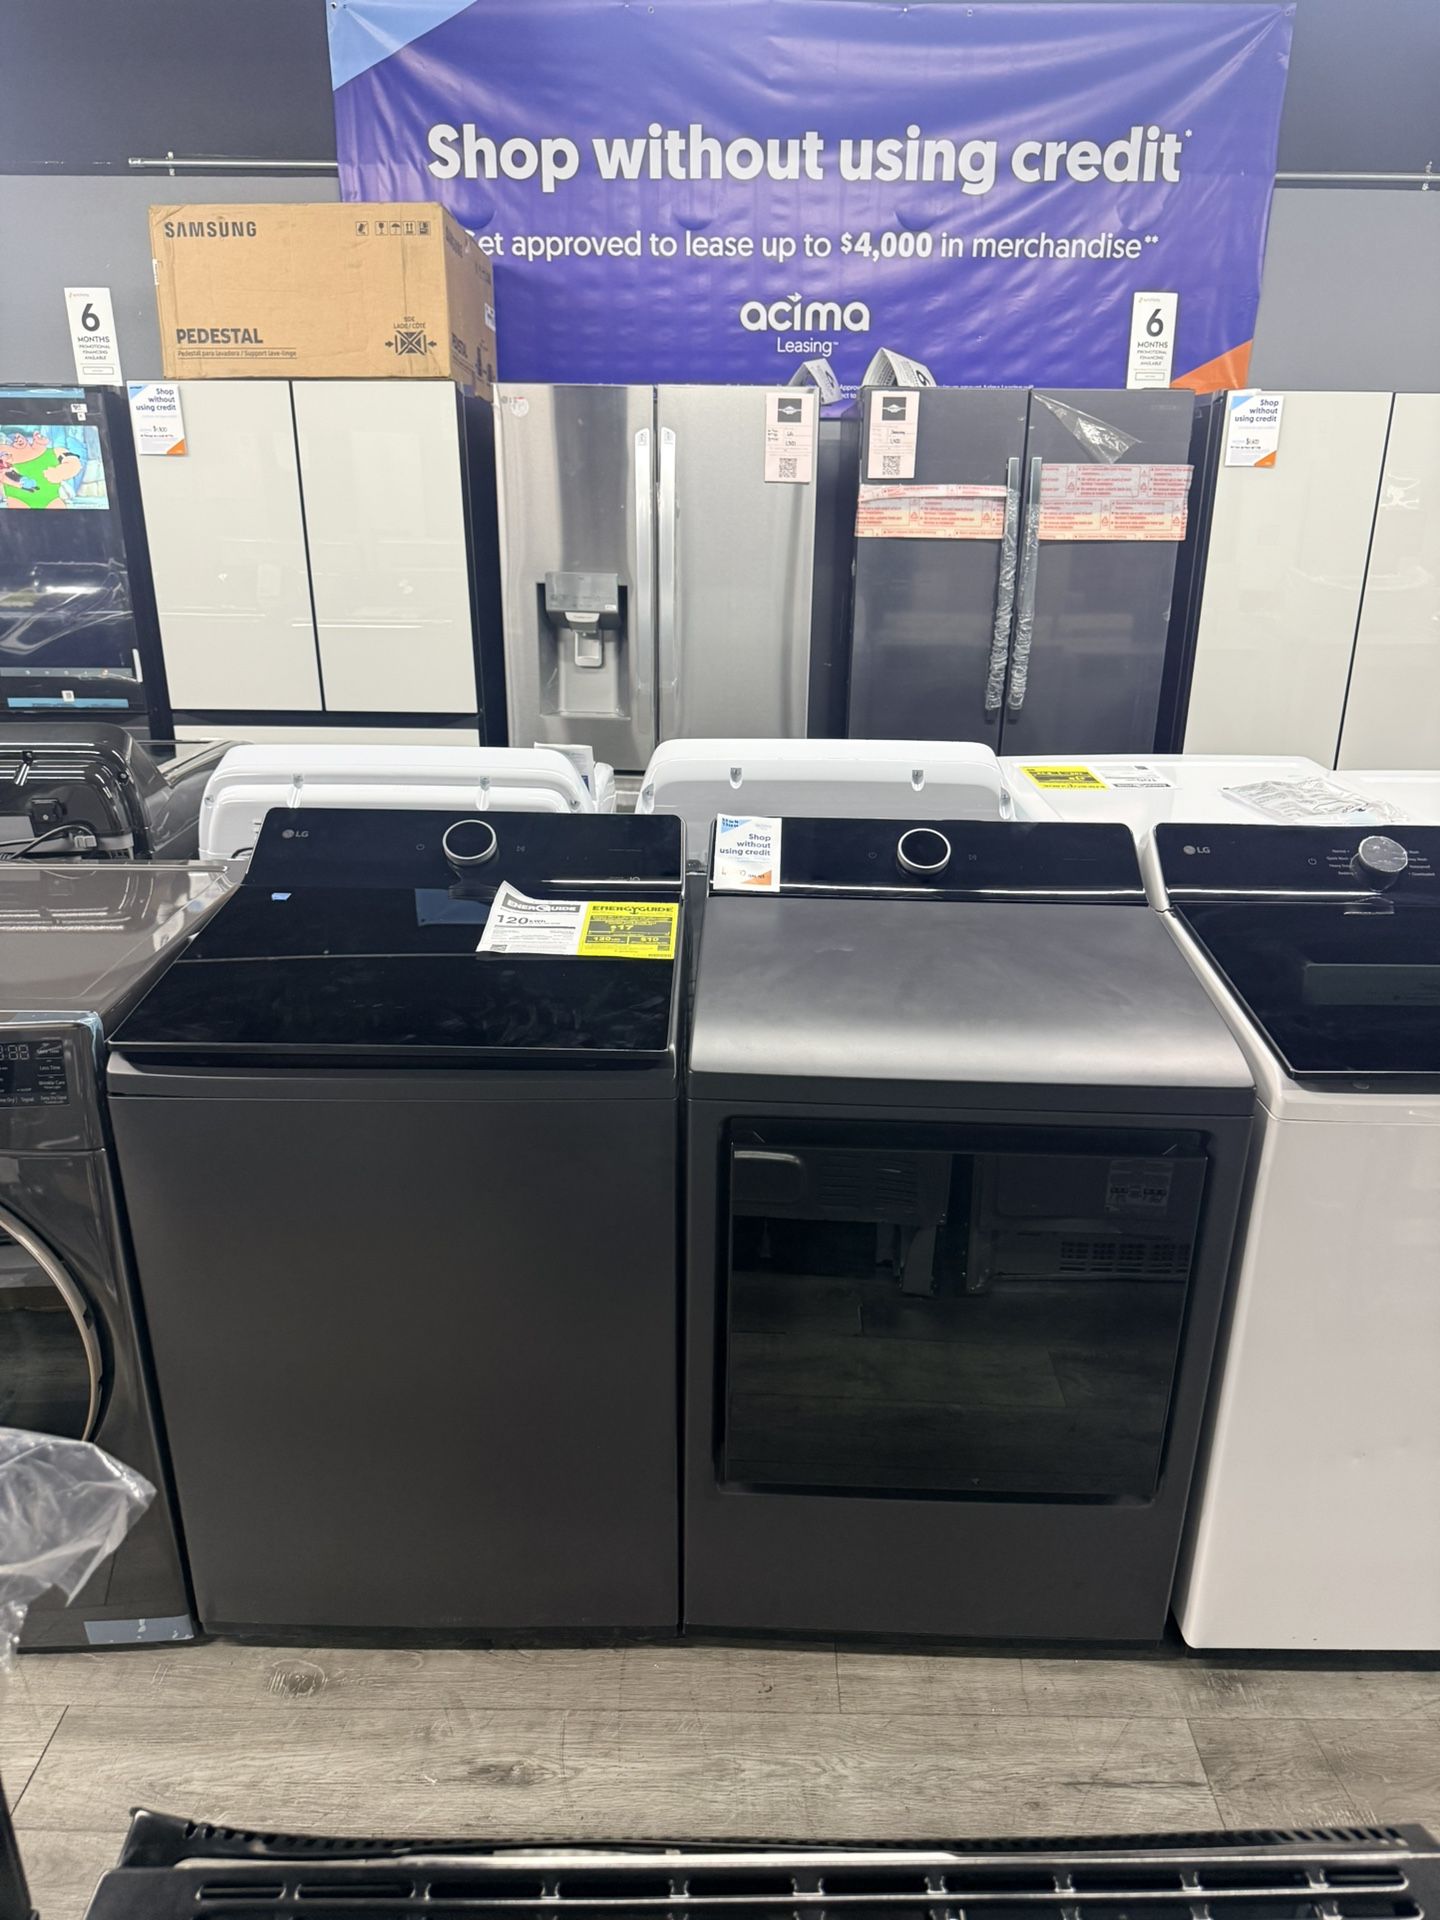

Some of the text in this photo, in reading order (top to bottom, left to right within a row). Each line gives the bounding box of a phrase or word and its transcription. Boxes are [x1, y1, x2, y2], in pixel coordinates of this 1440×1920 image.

[427, 122, 580, 193] Shop
[592, 122, 824, 181] without
[839, 124, 998, 196] using
[164, 221, 257, 238] SAMSUNG
[465, 229, 505, 257] et
[512, 230, 642, 262] approved
[650, 233, 677, 257] to
[686, 230, 754, 257] lease
[762, 235, 796, 263] up
[804, 235, 832, 257] to
[840, 232, 933, 262] $4,000
[941, 232, 963, 258] in
[739, 292, 871, 333] acima
[81, 303, 101, 332] 6
[1146, 308, 1164, 337] 6
[77, 335, 110, 343] MONTHS
[176, 328, 264, 344] PEDESTAL
[1137, 341, 1169, 349] MONTHS
[155, 388, 174, 396] Shop
[1260, 399, 1279, 407] Shop
[135, 404, 156, 412] using
[1234, 415, 1255, 423] using
[295, 830, 309, 838] LG
[748, 833, 772, 842] Shop
[719, 848, 771, 856] using credit
[1196, 846, 1211, 854] LG
[592, 905, 674, 915] ENERGYGUIDE
[497, 914, 529, 925] 120
